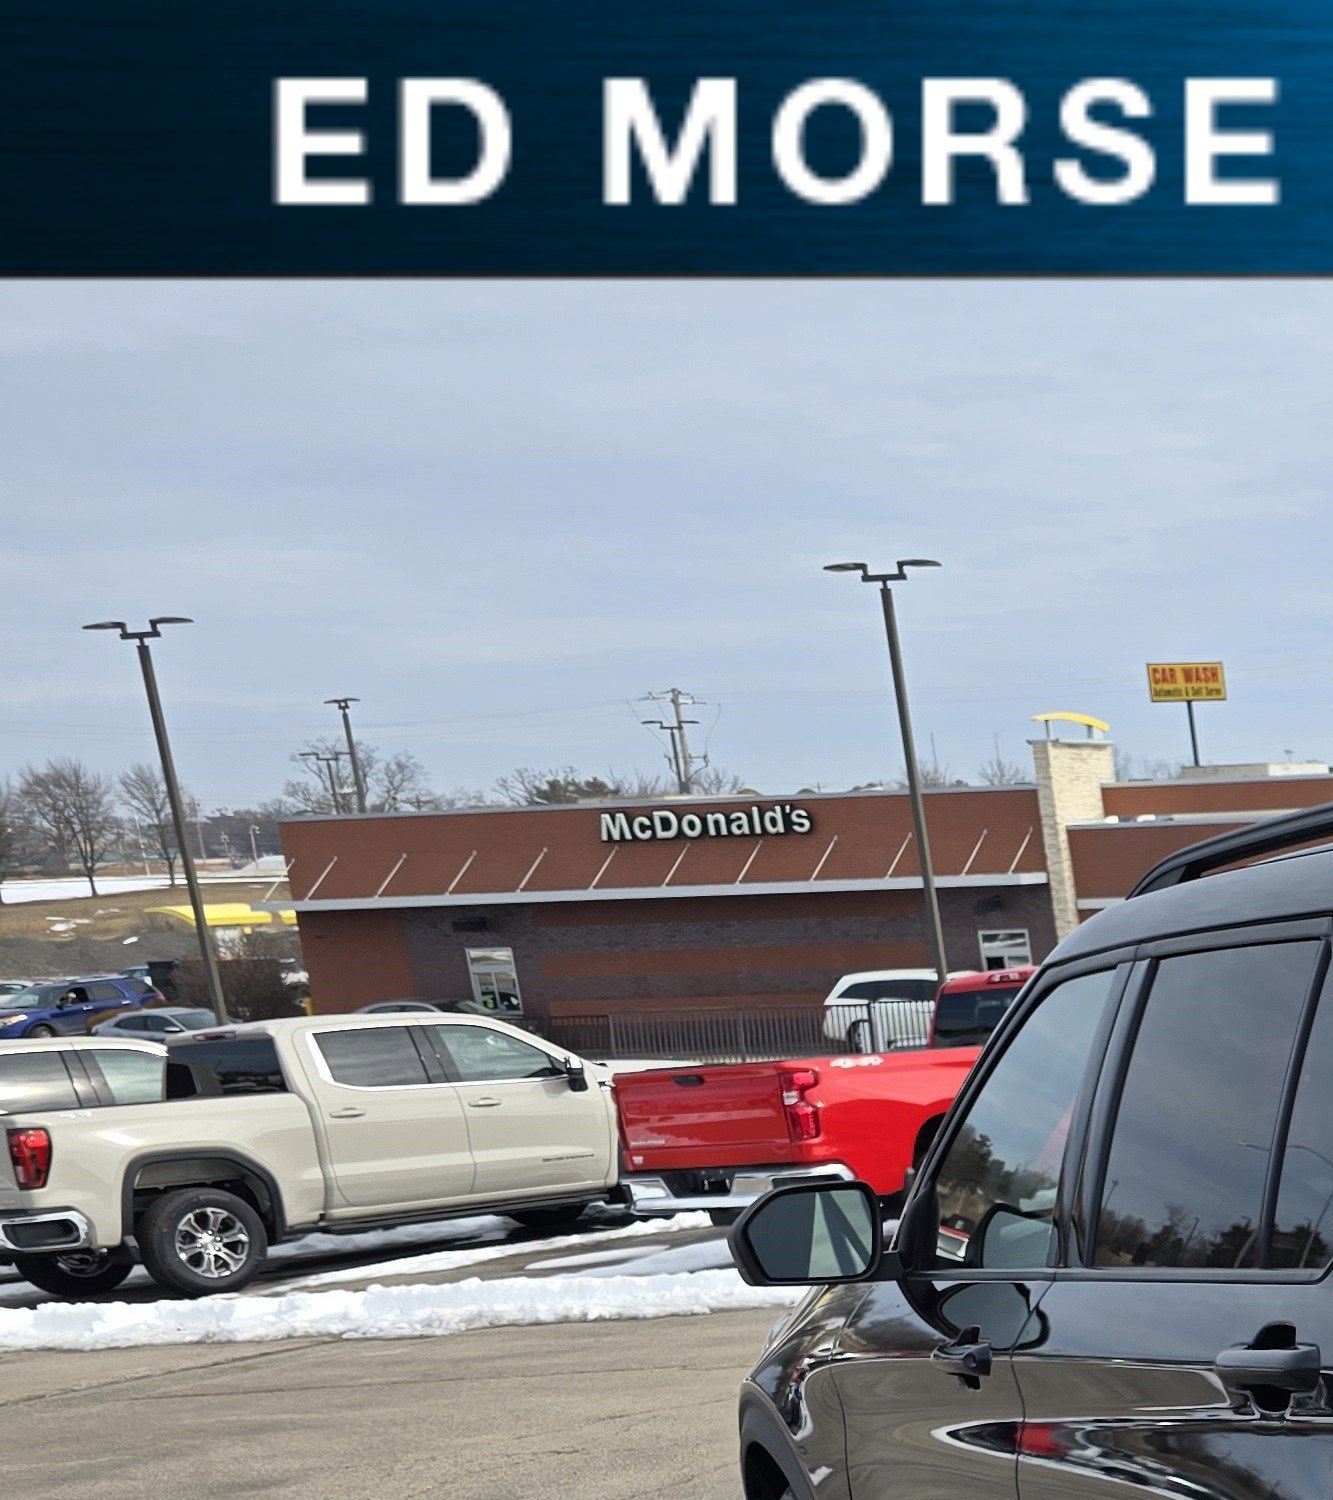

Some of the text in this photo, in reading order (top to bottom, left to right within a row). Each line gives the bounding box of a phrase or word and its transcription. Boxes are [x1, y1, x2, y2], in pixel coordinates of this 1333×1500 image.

[1151, 666, 1219, 685] CAR WASH
[600, 805, 812, 842] McDonald's
